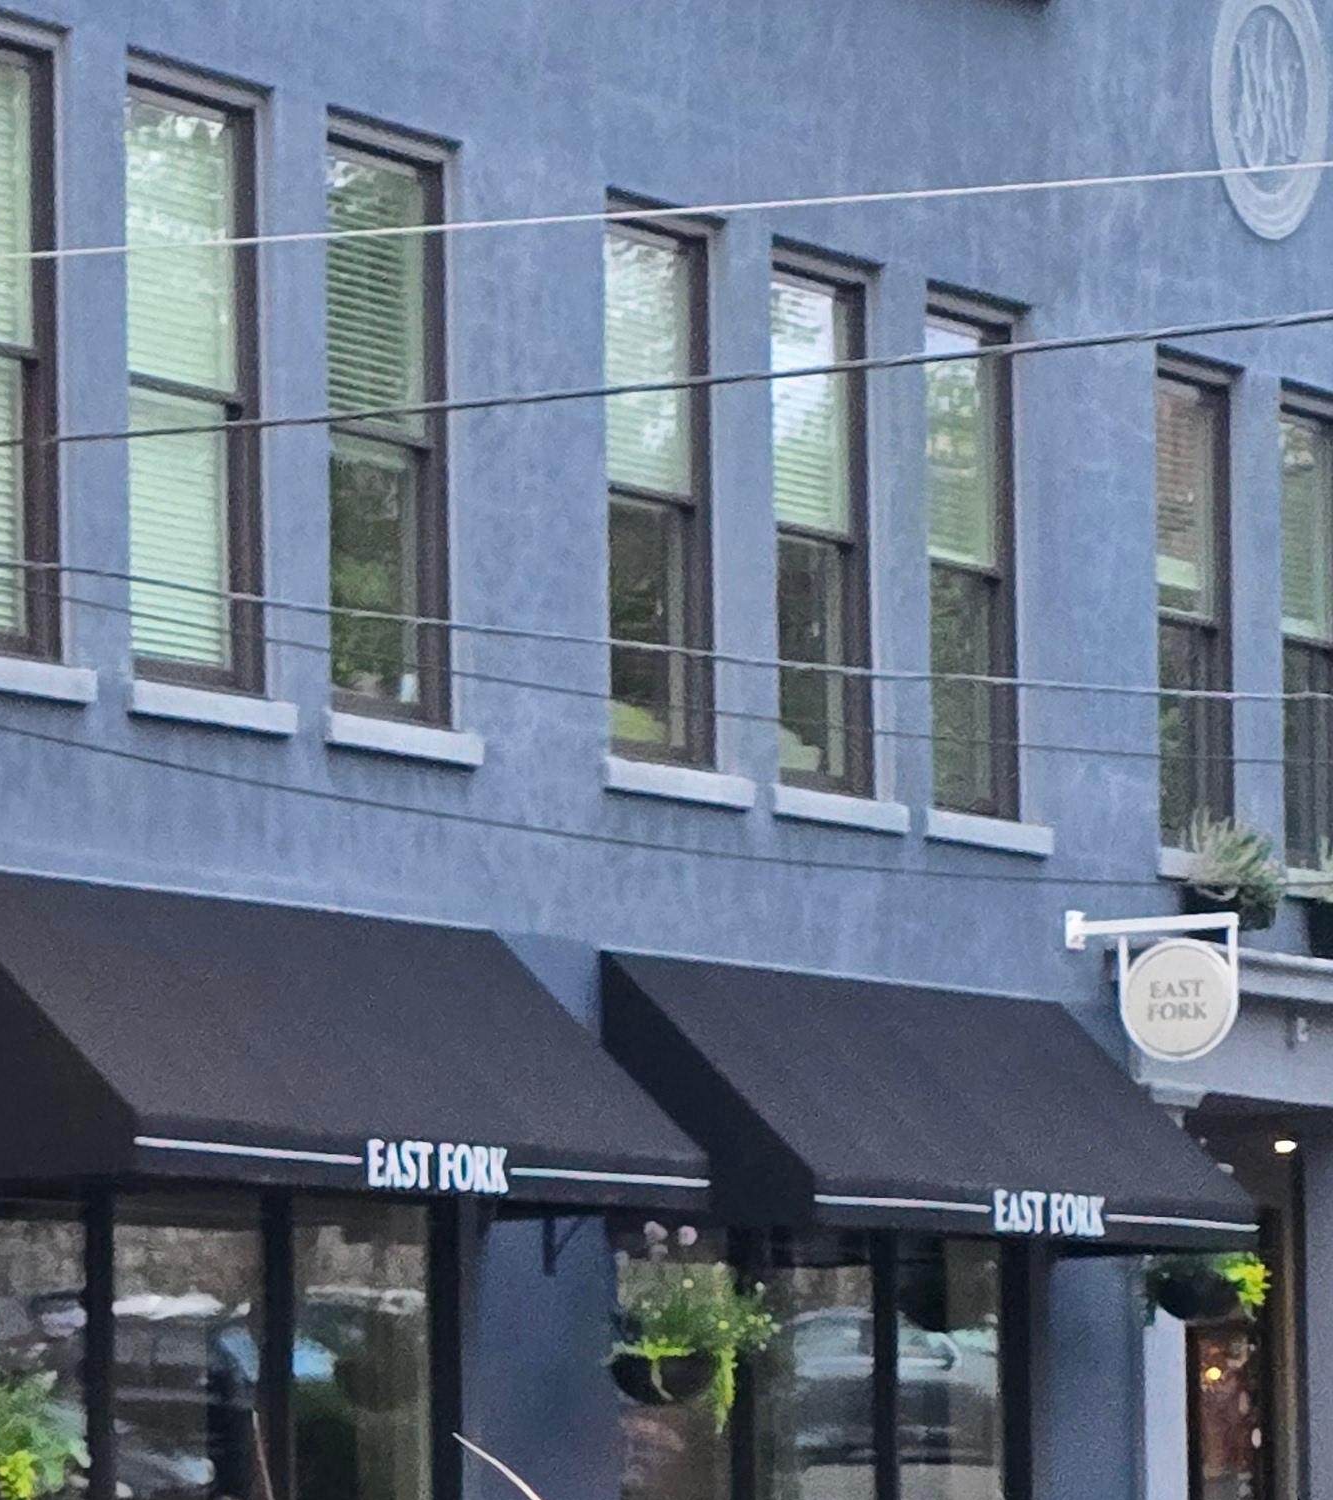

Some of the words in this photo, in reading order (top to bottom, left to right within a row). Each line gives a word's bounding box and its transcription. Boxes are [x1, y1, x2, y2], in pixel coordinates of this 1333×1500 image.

[1149, 979, 1205, 998] EAST
[1147, 1001, 1208, 1021] FORK
[367, 1138, 433, 1189] EAST
[438, 1143, 508, 1193] FORK
[994, 1188, 1047, 1233] EAST
[1050, 1192, 1106, 1237] FORK
